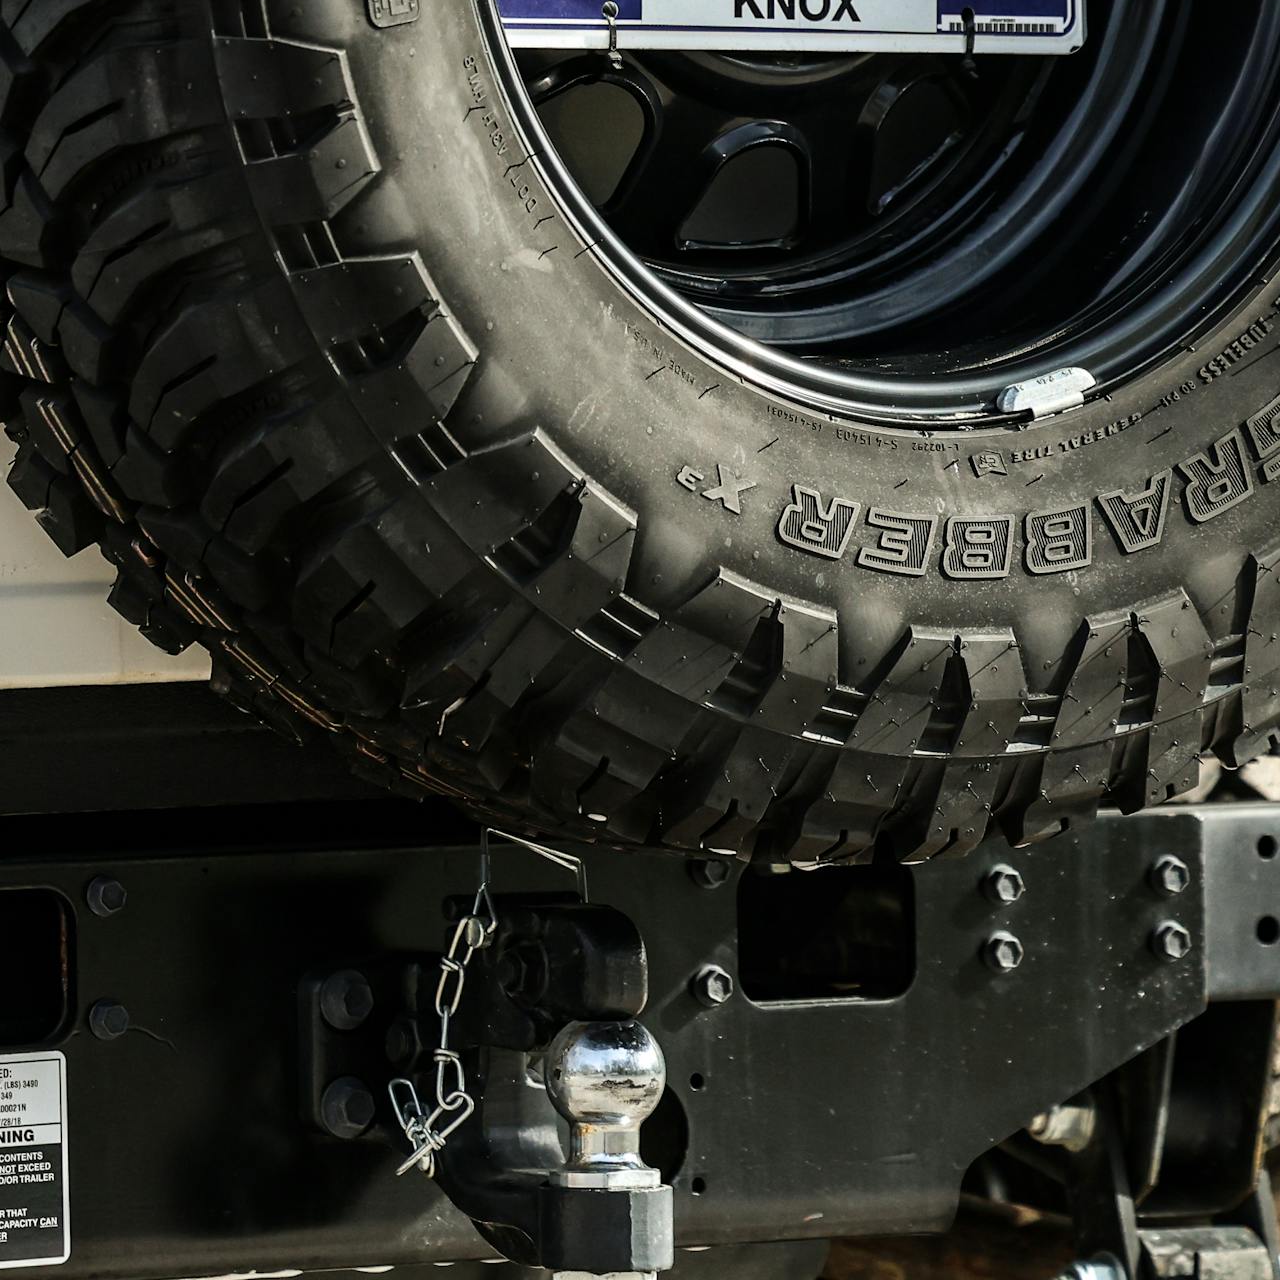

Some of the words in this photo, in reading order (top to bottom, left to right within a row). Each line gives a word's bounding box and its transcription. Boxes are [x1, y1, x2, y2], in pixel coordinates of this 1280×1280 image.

[512, 177, 538, 214] DOT
[1198, 314, 1275, 384] TUBELESS
[1067, 412, 1142, 459] GENERAL
[1010, 438, 1058, 462] TIRE
[4, 1081, 21, 1090] (LBS)
[23, 1080, 38, 1088] 3490
[1, 1092, 12, 1100] 349
[0, 1165, 16, 1175] NOT
[18, 1162, 51, 1173] EXCEED
[20, 1173, 54, 1183] TRAILER
[7, 1208, 28, 1217] THAT
[40, 1217, 58, 1226] CAN
